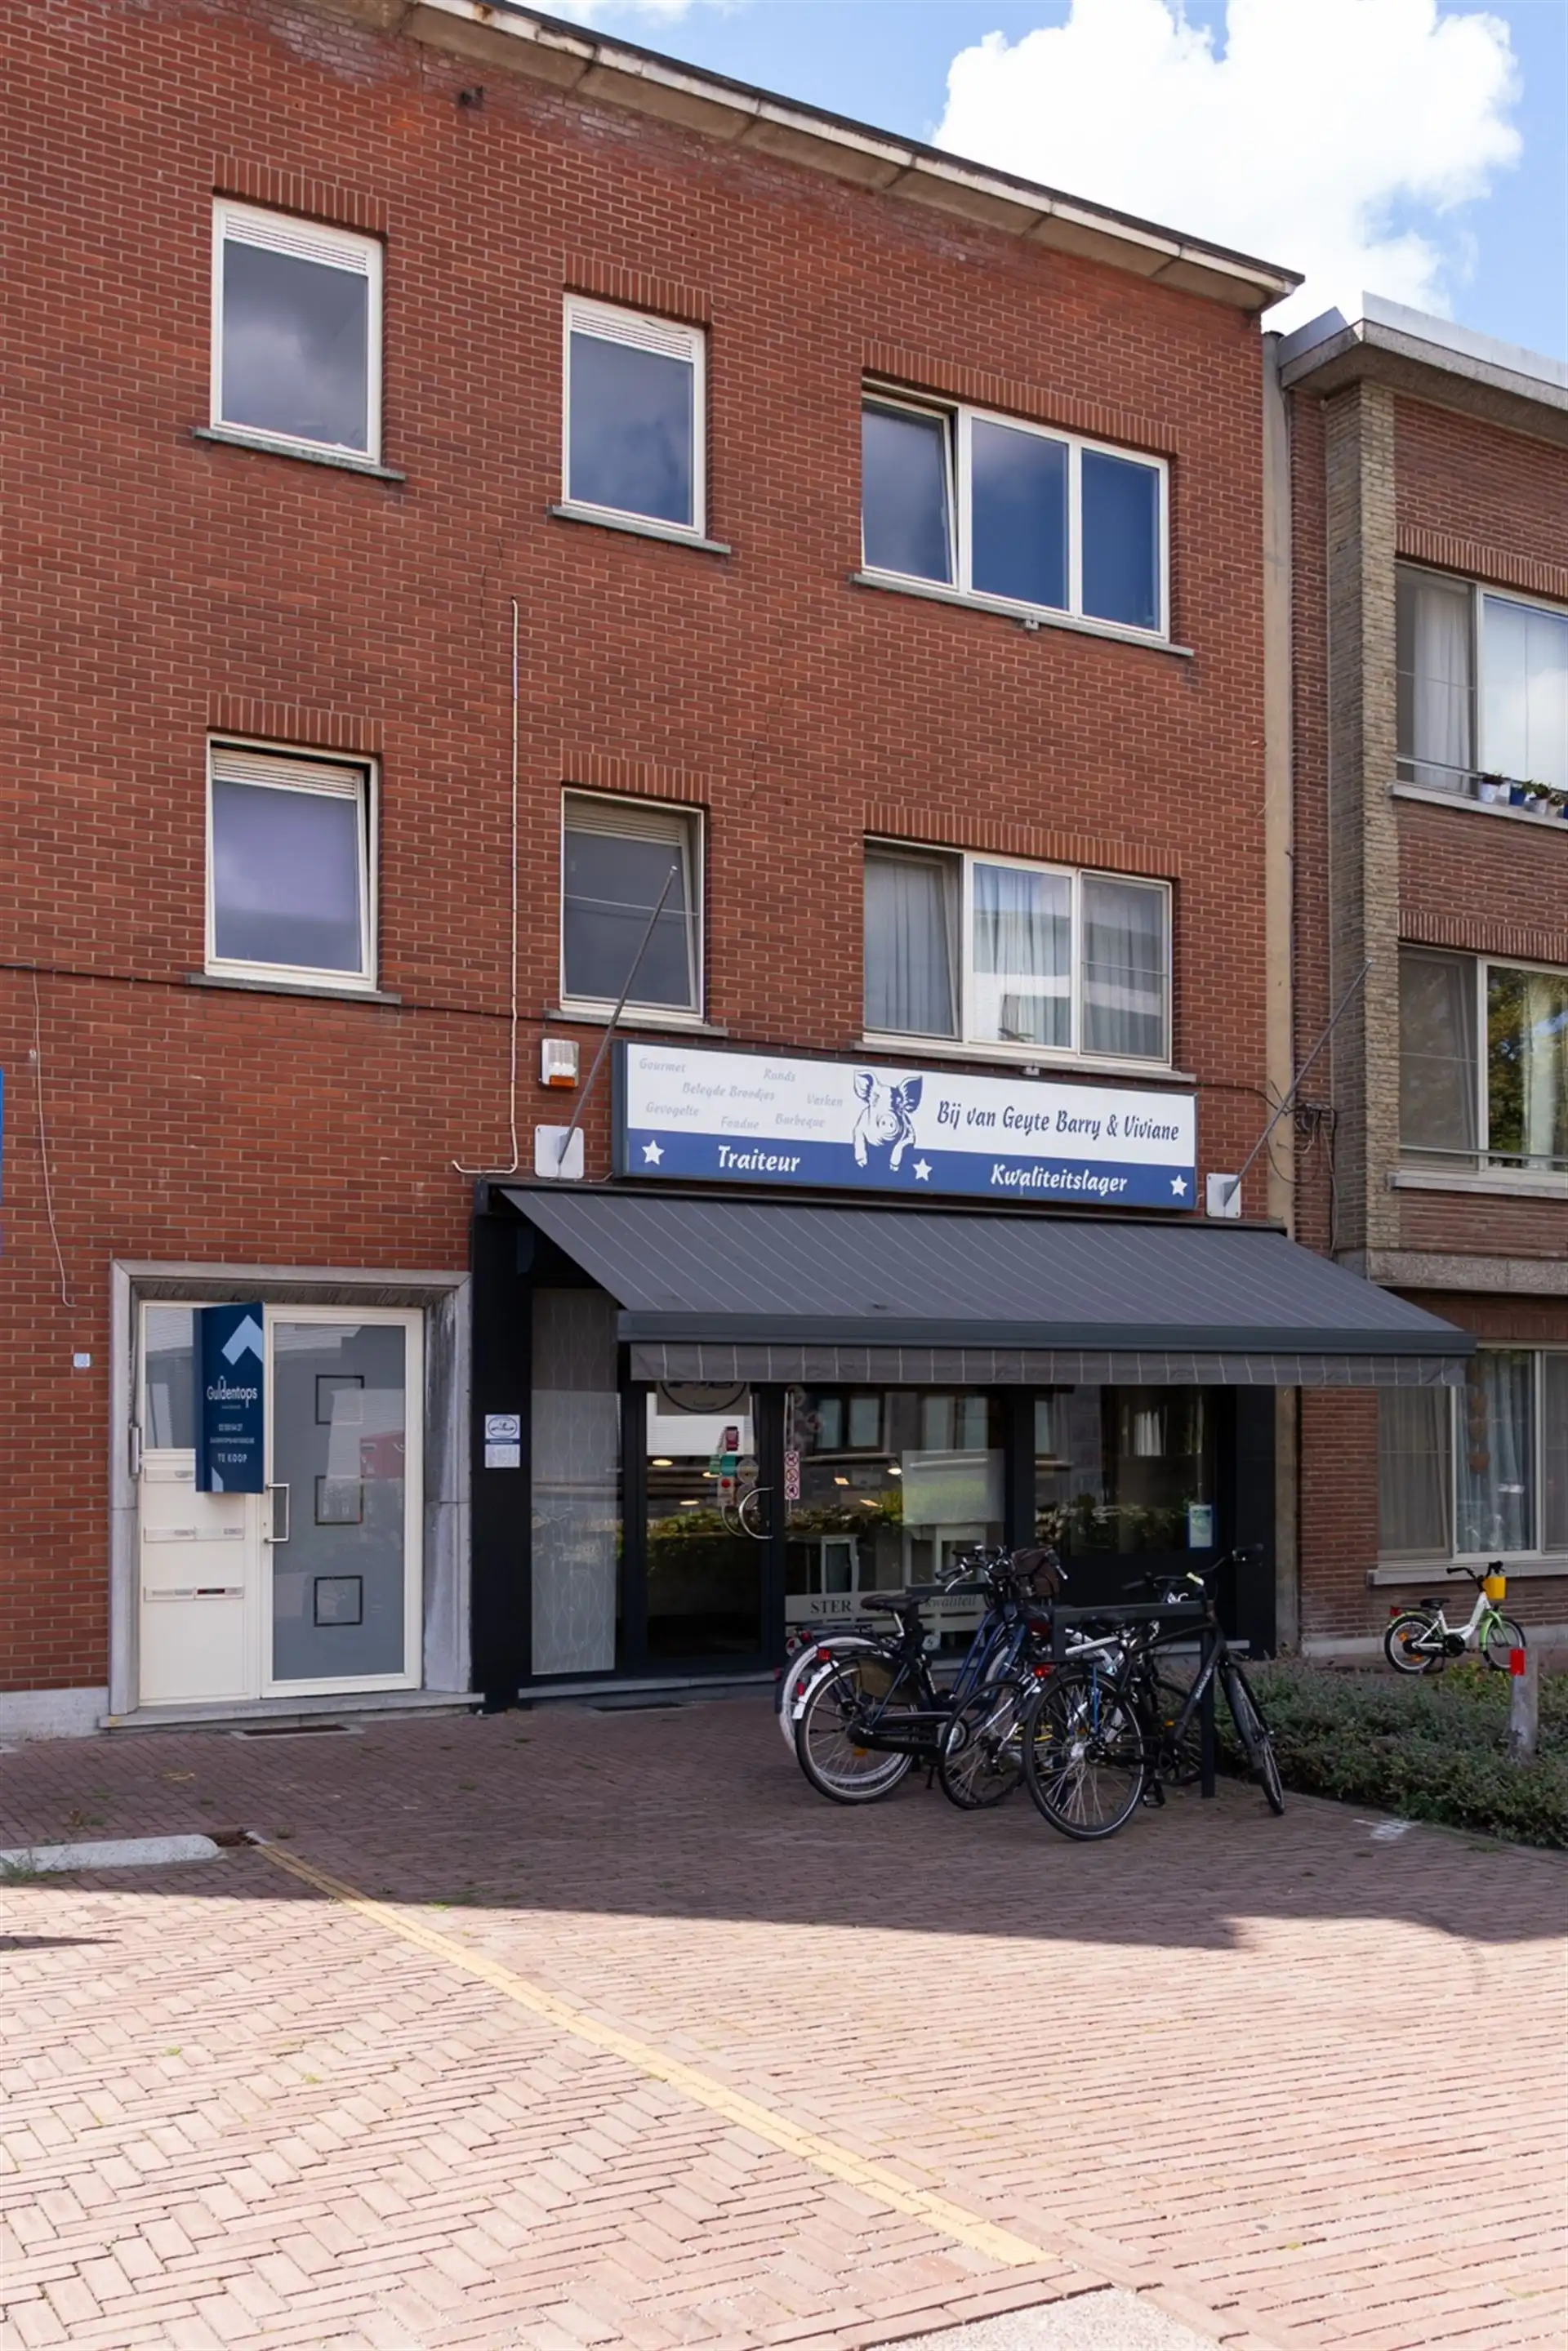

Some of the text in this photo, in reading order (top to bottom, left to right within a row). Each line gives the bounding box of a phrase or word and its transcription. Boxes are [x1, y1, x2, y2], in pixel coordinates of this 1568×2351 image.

[639, 1058, 686, 1073] Gourmet
[682, 1082, 775, 1102] Belegde Broodjes
[807, 1093, 843, 1107] Varken
[645, 1101, 700, 1118] Gevogelte
[720, 1115, 760, 1130] Fondue
[937, 1100, 1180, 1142] Bij van Geyte Barry & Viviane
[718, 1145, 801, 1173] Traiteur
[990, 1164, 1128, 1196] Kwaliteitslager
[207, 1375, 258, 1409] Guldentops
[227, 1454, 247, 1463] KOOP
[810, 1600, 854, 1614] STER
